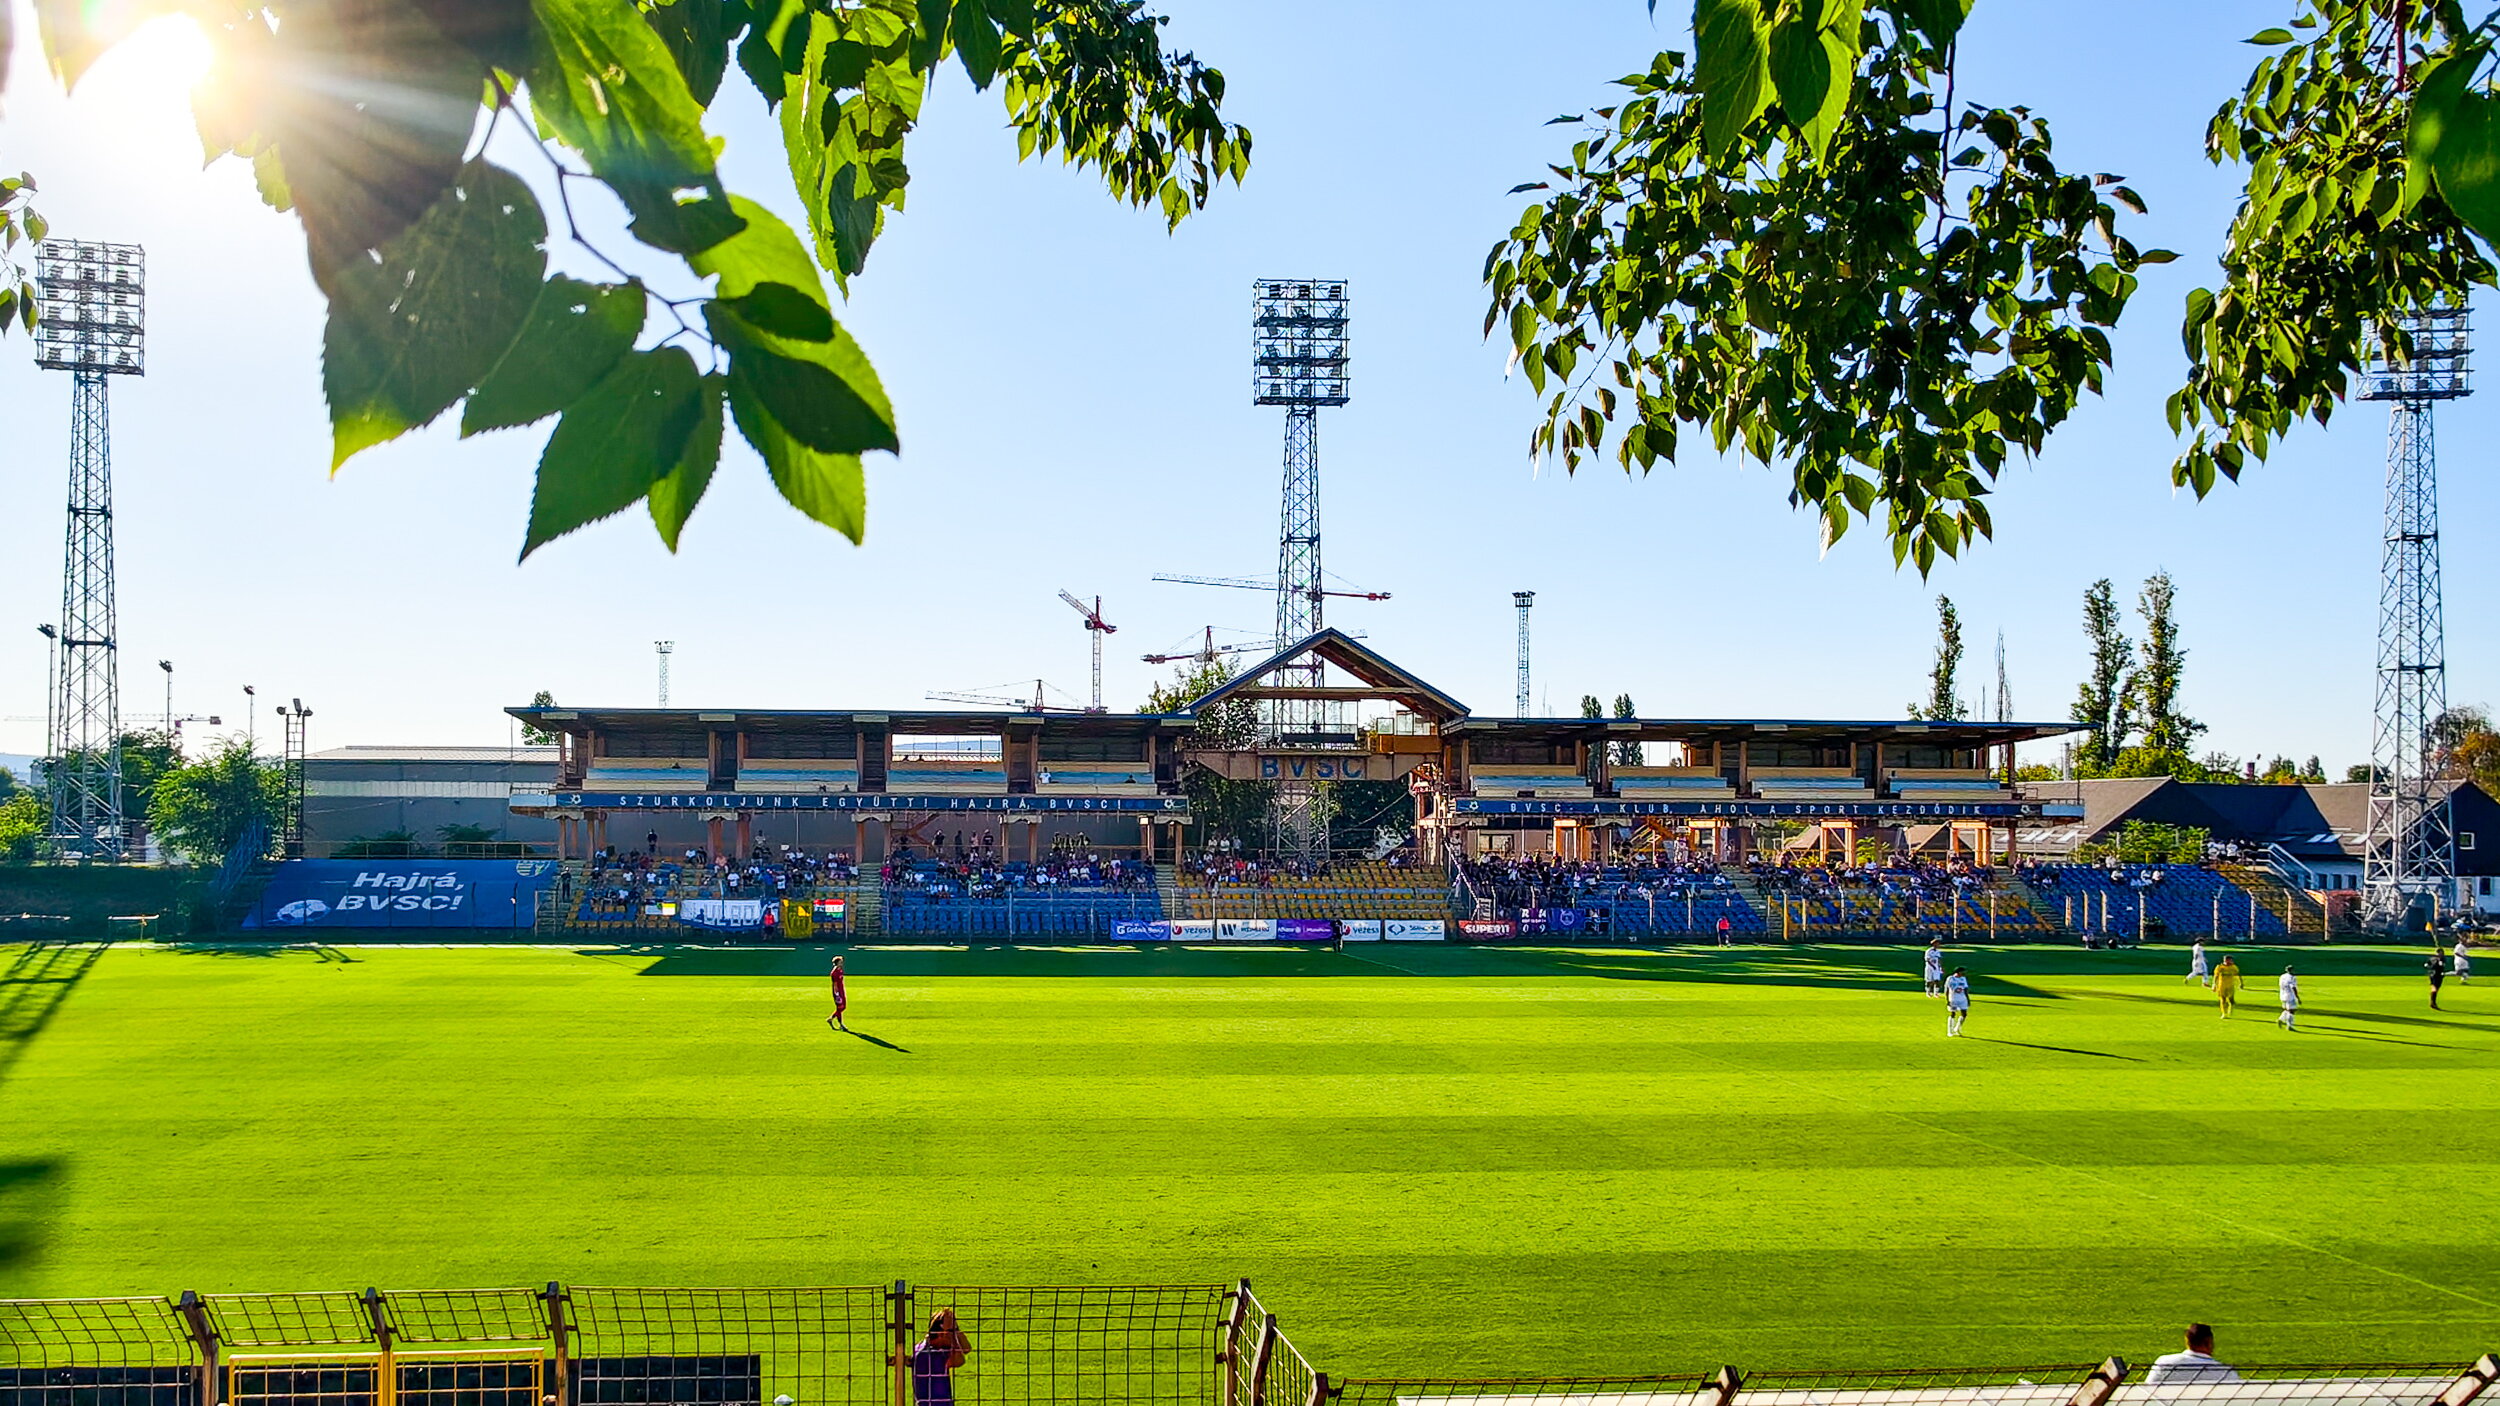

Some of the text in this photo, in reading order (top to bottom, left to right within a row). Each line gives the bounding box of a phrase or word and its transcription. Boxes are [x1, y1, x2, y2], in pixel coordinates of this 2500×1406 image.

[1261, 757, 1363, 779] BVSC
[619, 795, 799, 807] SZURKOLJUNK
[950, 797, 1030, 810] HAJRÁ,
[1049, 798, 1121, 810] BVSC!
[1593, 803, 1600, 813] A
[1769, 804, 1776, 814] A
[1795, 804, 1859, 814] SPORT
[352, 872, 465, 892] Hajrá,
[335, 895, 464, 911] BVSC!
